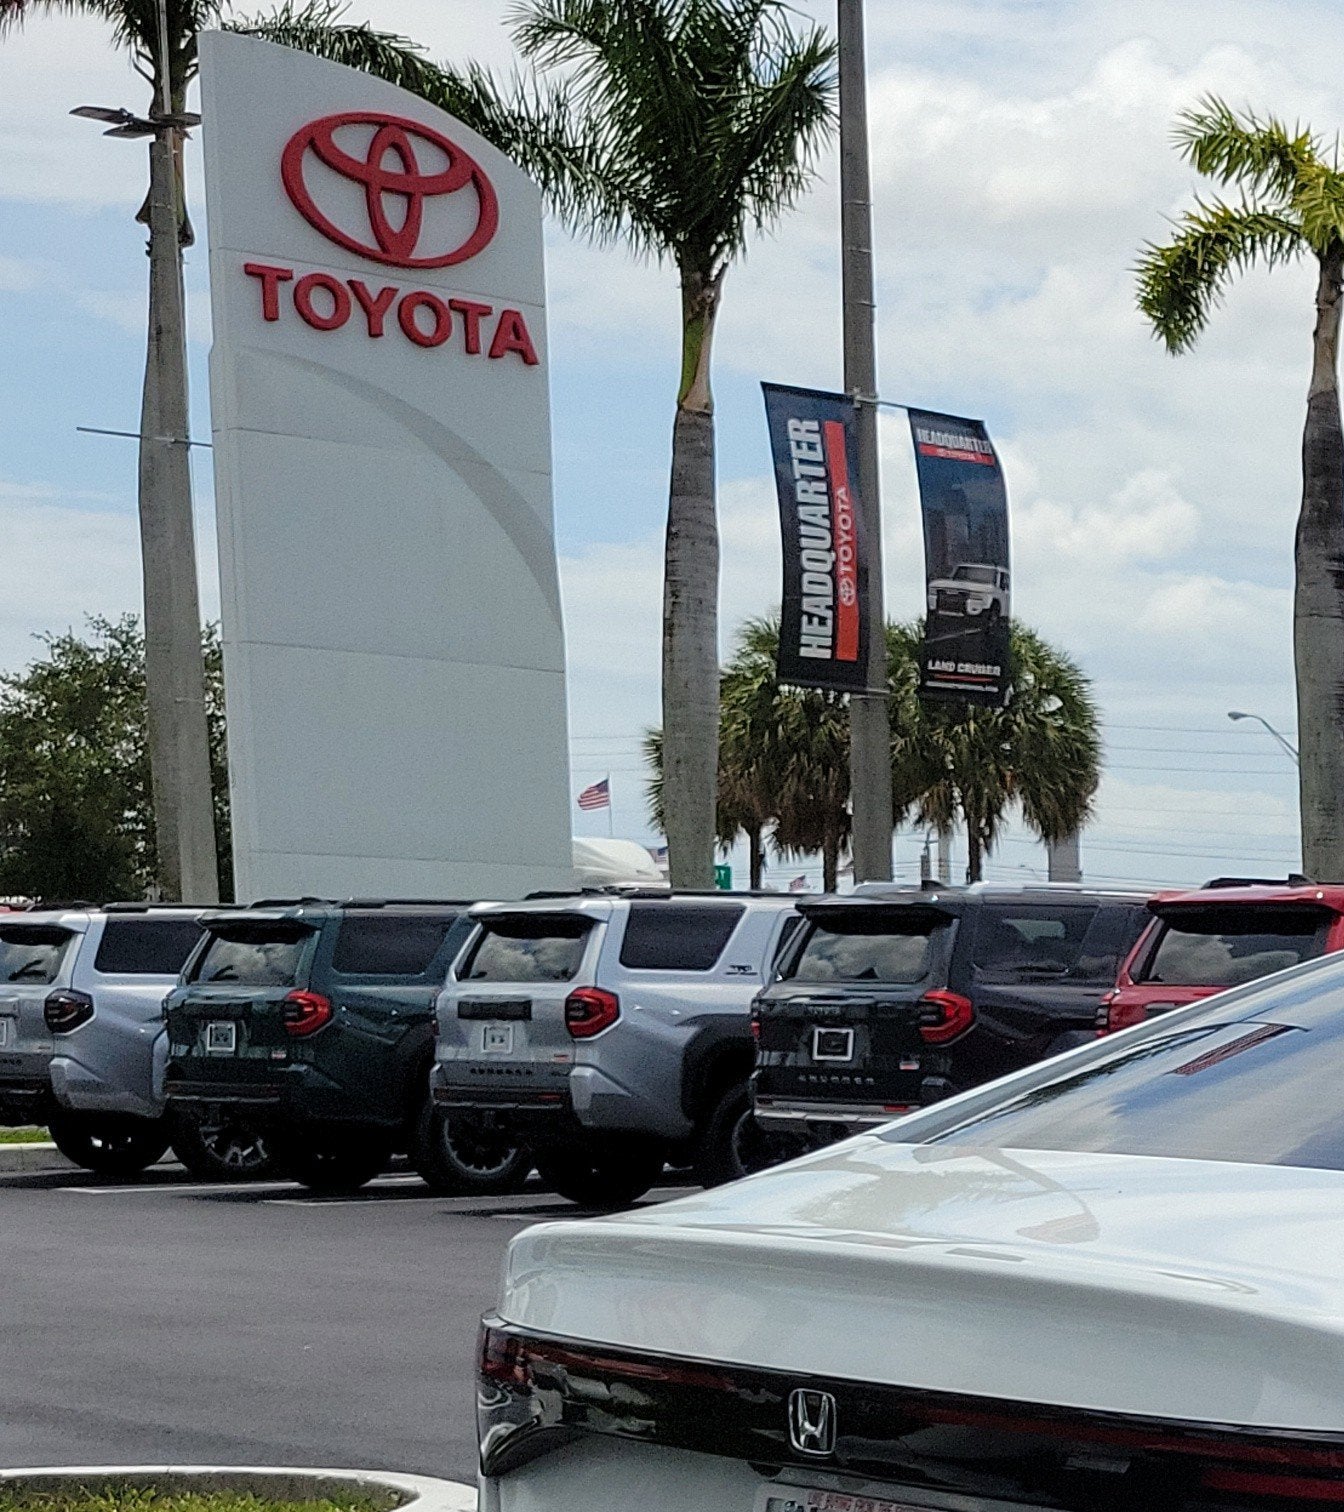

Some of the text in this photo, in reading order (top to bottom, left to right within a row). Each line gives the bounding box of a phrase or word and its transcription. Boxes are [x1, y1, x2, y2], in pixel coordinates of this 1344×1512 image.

[244, 263, 539, 365] TOYOTA
[788, 418, 834, 660] HEADQUARTER
[837, 487, 853, 574] TOYOTA
[926, 659, 955, 673] LAND
